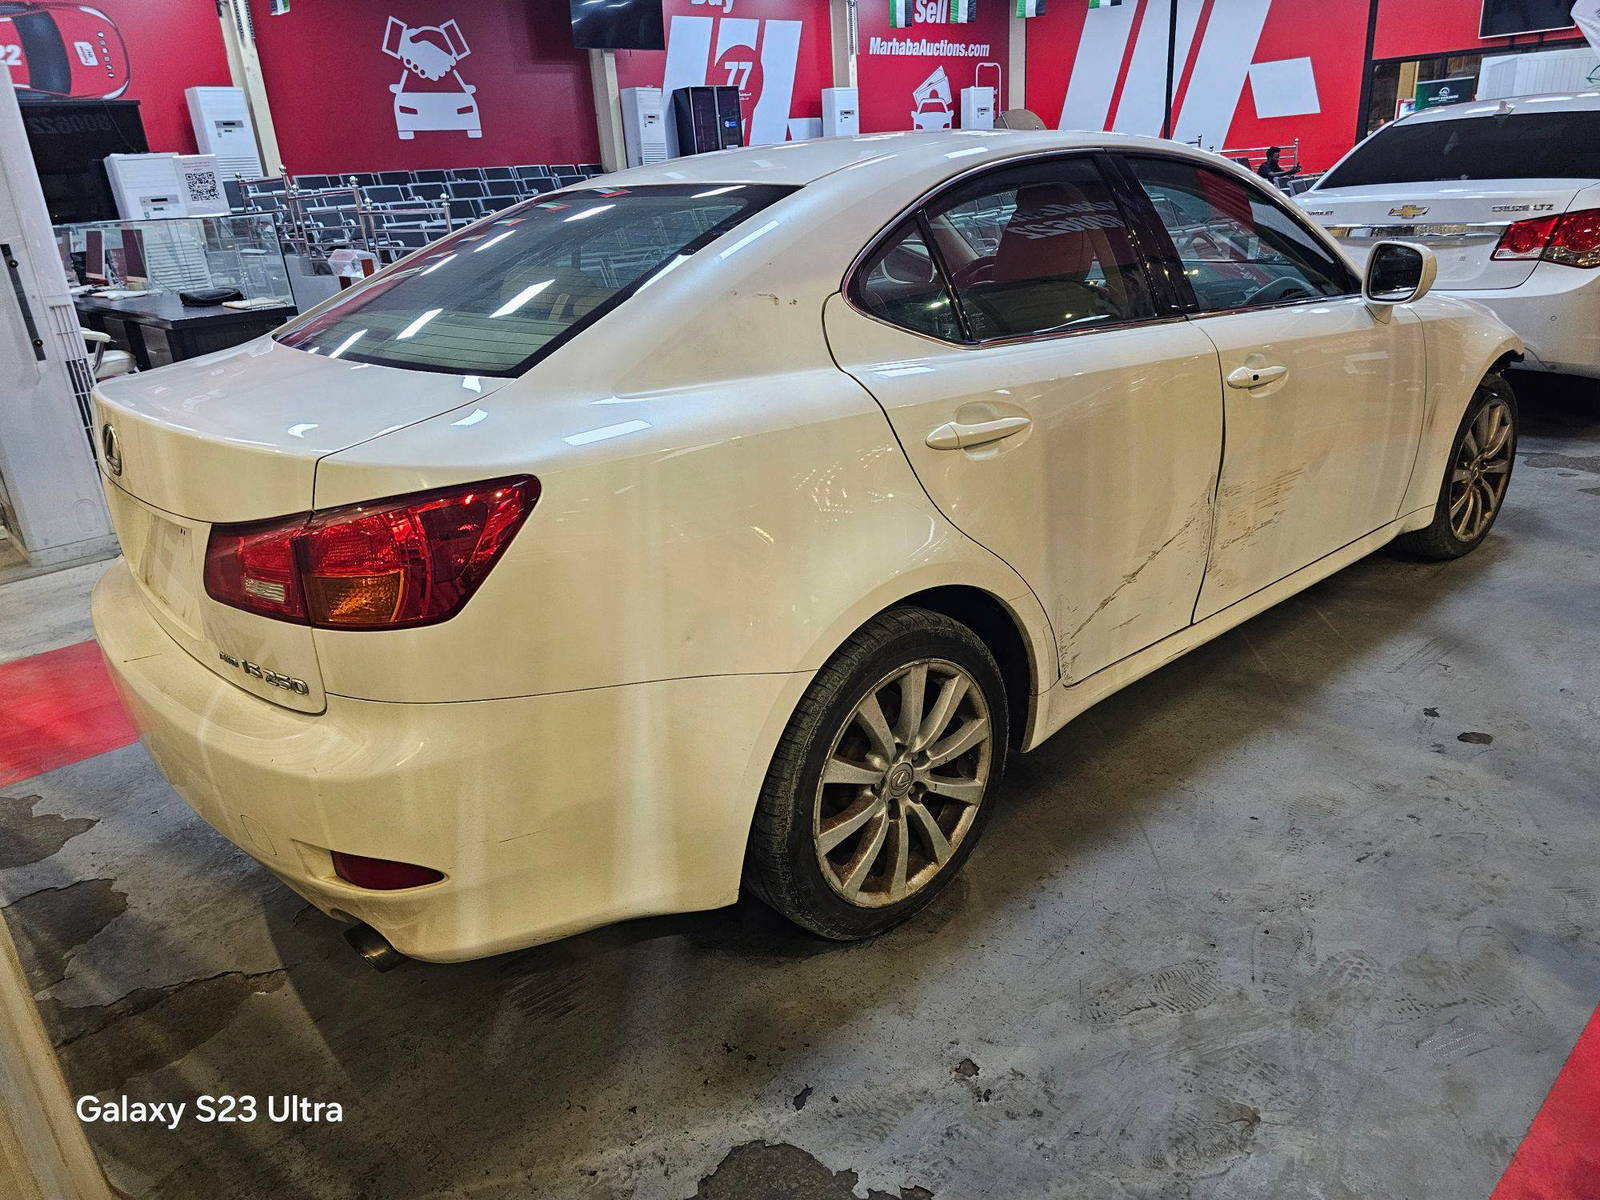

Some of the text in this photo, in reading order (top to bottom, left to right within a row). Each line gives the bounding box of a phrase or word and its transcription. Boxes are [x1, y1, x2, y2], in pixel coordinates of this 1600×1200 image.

[914, 0, 947, 24] Sell
[869, 37, 990, 57] MarhabaAuctions.com
[724, 61, 753, 91] 77
[1492, 203, 1554, 213] CRUZE LTZ
